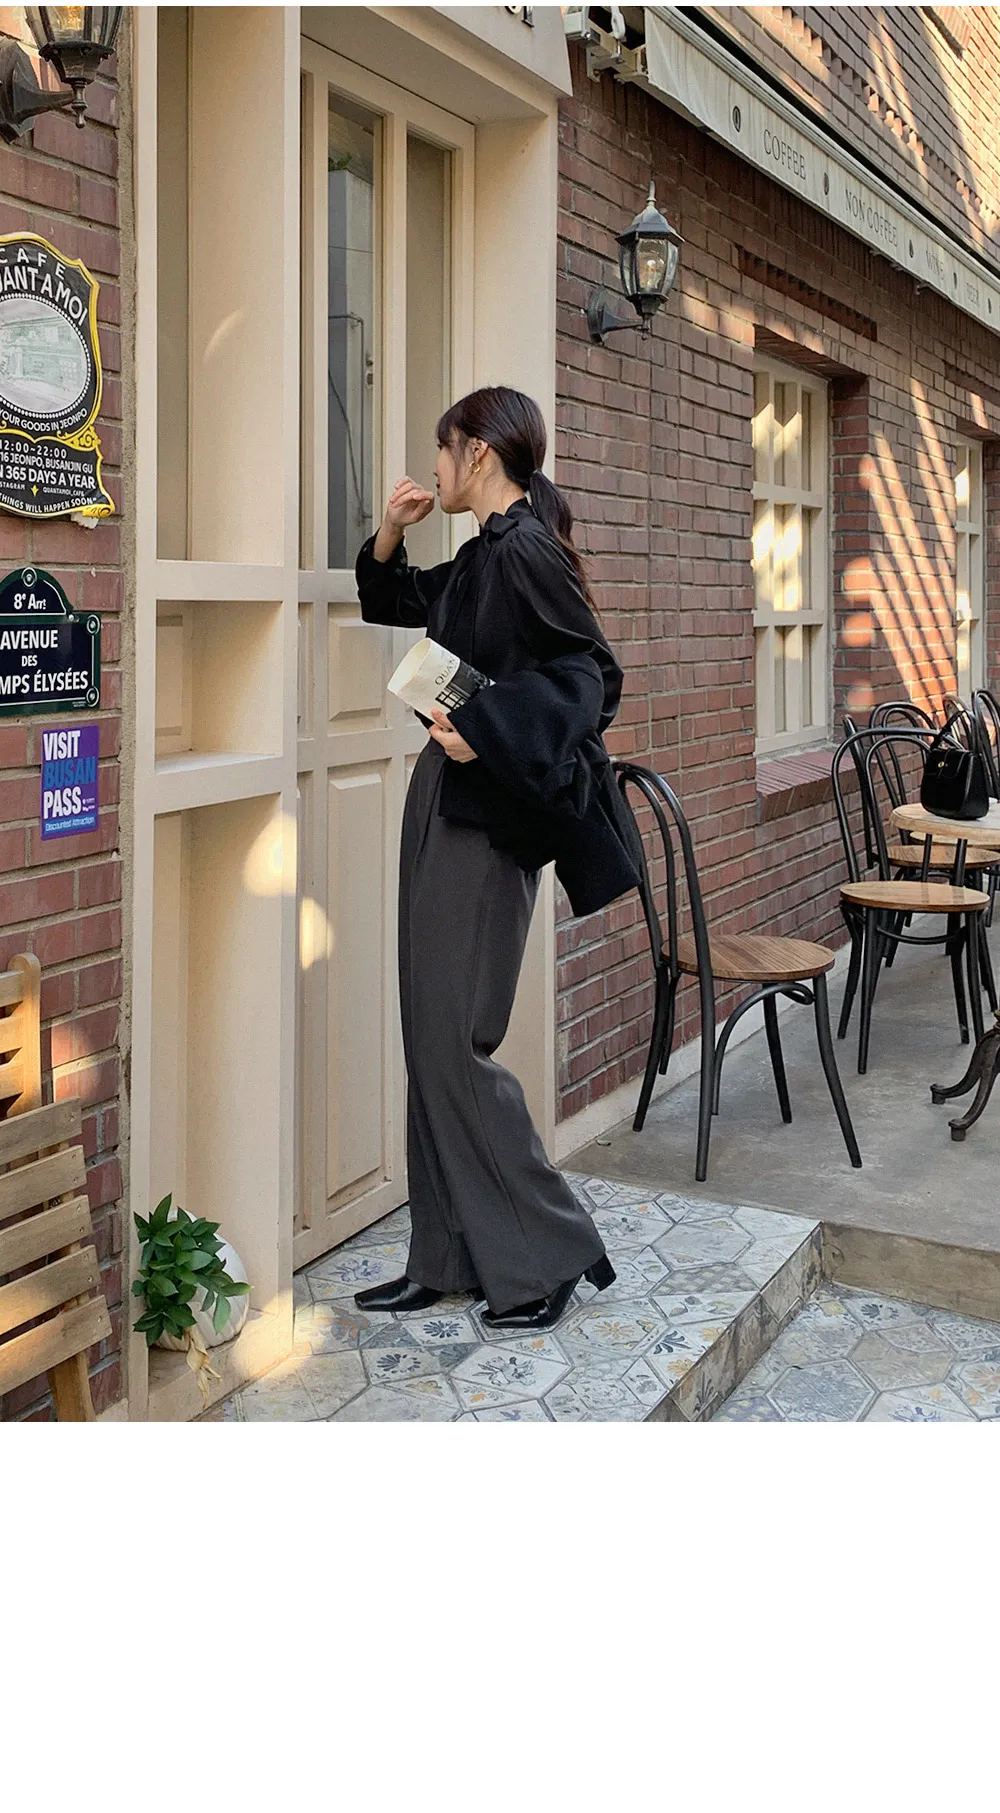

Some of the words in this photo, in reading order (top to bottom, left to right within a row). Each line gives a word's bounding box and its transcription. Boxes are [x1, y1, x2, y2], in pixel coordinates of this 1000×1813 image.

[763, 129, 807, 180] COFFEE
[845, 189, 865, 221] NON
[867, 206, 898, 247] COFFEE
[20, 418, 51, 432] GOODS
[51, 421, 60, 431] IN
[60, 407, 88, 429] JEONPO
[10, 454, 45, 469] JEONPO,
[45, 458, 81, 472] BUSANJIN
[82, 463, 93, 474] GU
[5, 466, 27, 481] 365
[28, 468, 57, 485] DAYS
[58, 472, 67, 486] A
[67, 473, 96, 489] YEAR
[25, 502, 42, 513] WILL
[43, 500, 71, 513] HAPPEN
[0, 630, 58, 650] AVENUE
[21, 655, 38, 667] DES
[34, 667, 88, 692] ÉLYSÉES
[43, 729, 81, 761] VISIT
[43, 756, 96, 790] BUSAN
[43, 786, 81, 819] PASS
